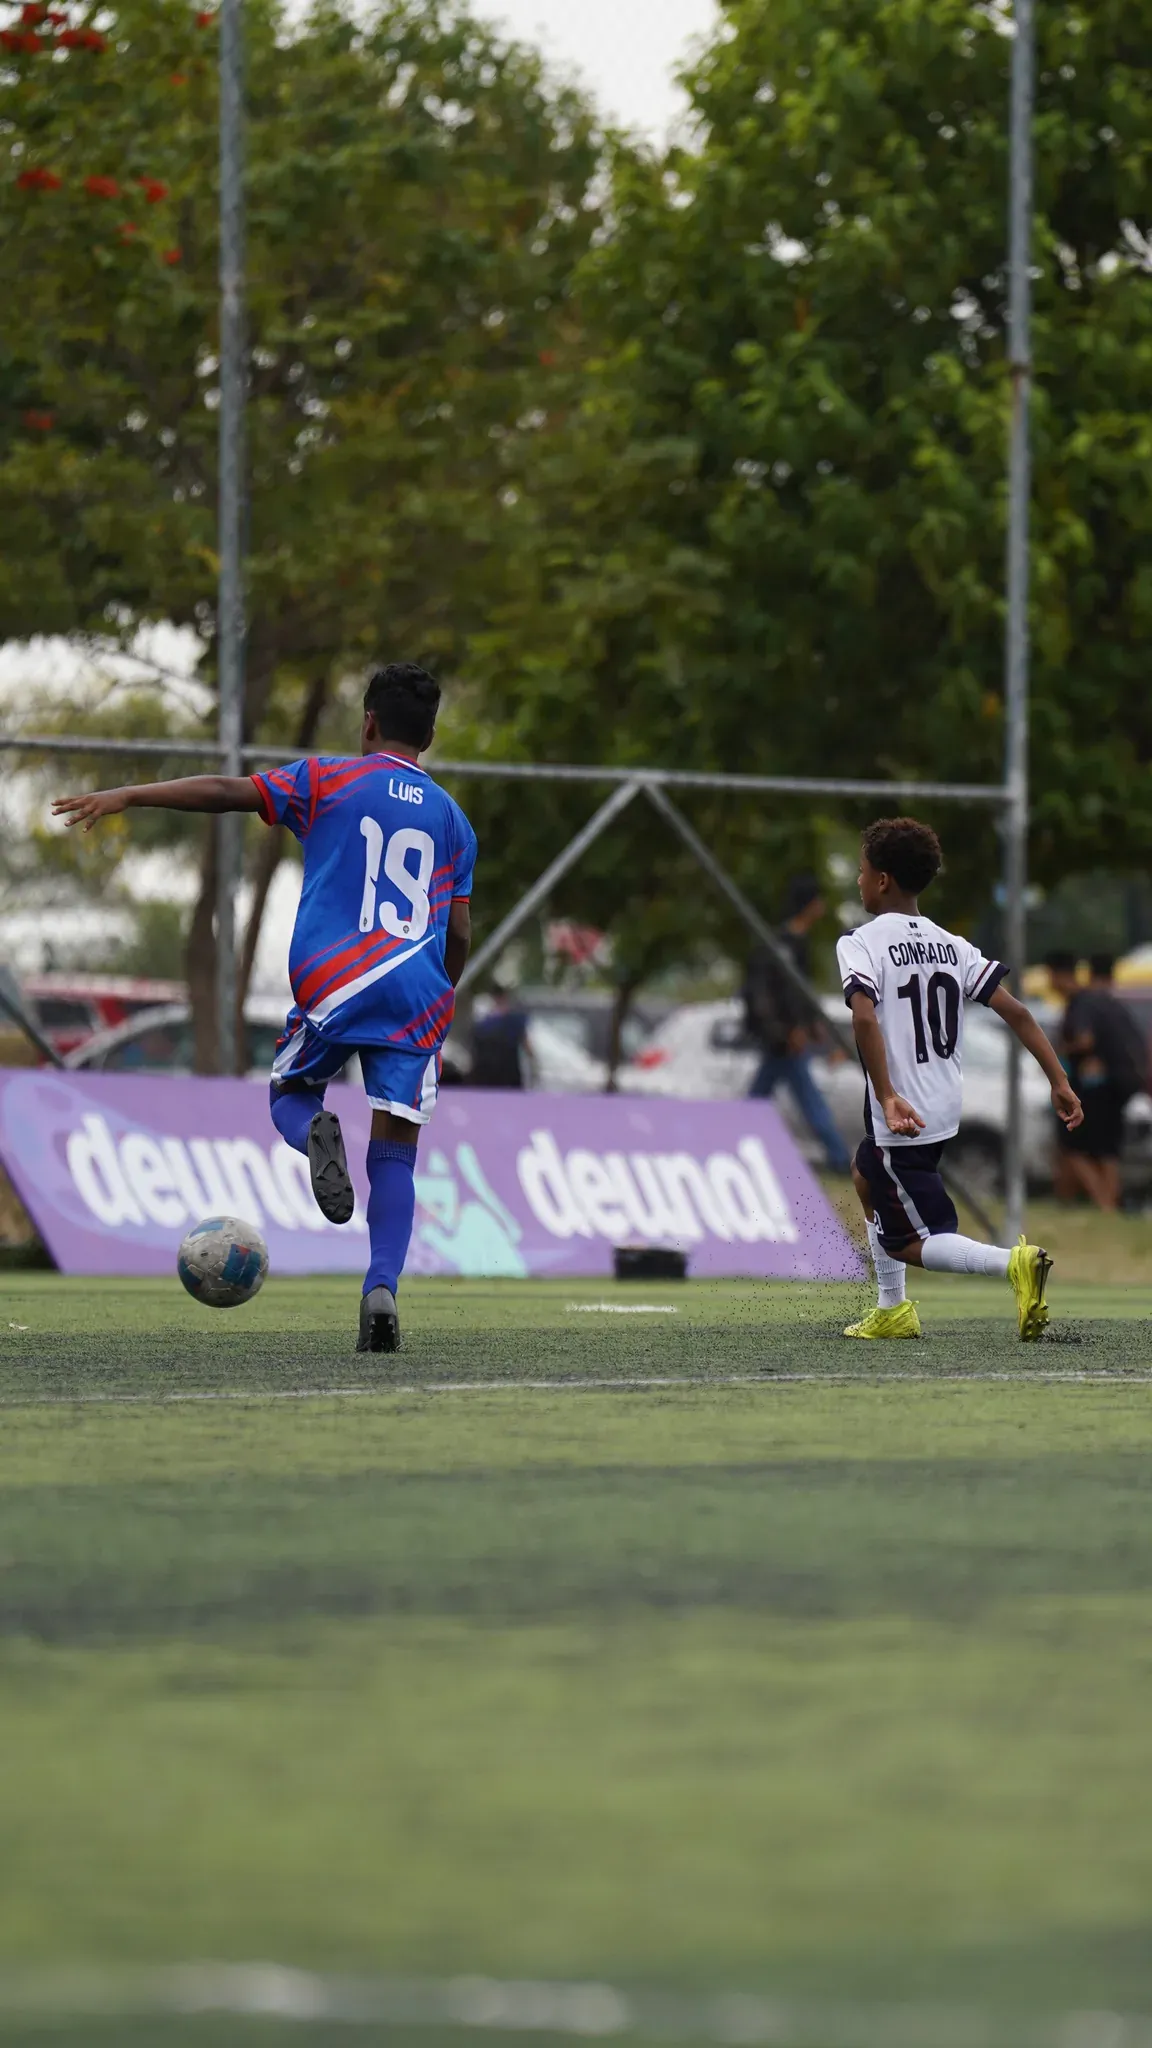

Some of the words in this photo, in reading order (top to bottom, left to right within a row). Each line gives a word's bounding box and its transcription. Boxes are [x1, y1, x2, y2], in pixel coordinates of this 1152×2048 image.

[388, 778, 424, 805] LUIS
[358, 815, 435, 942] 19
[888, 941, 958, 967] CONRADO
[897, 971, 960, 1064] 10
